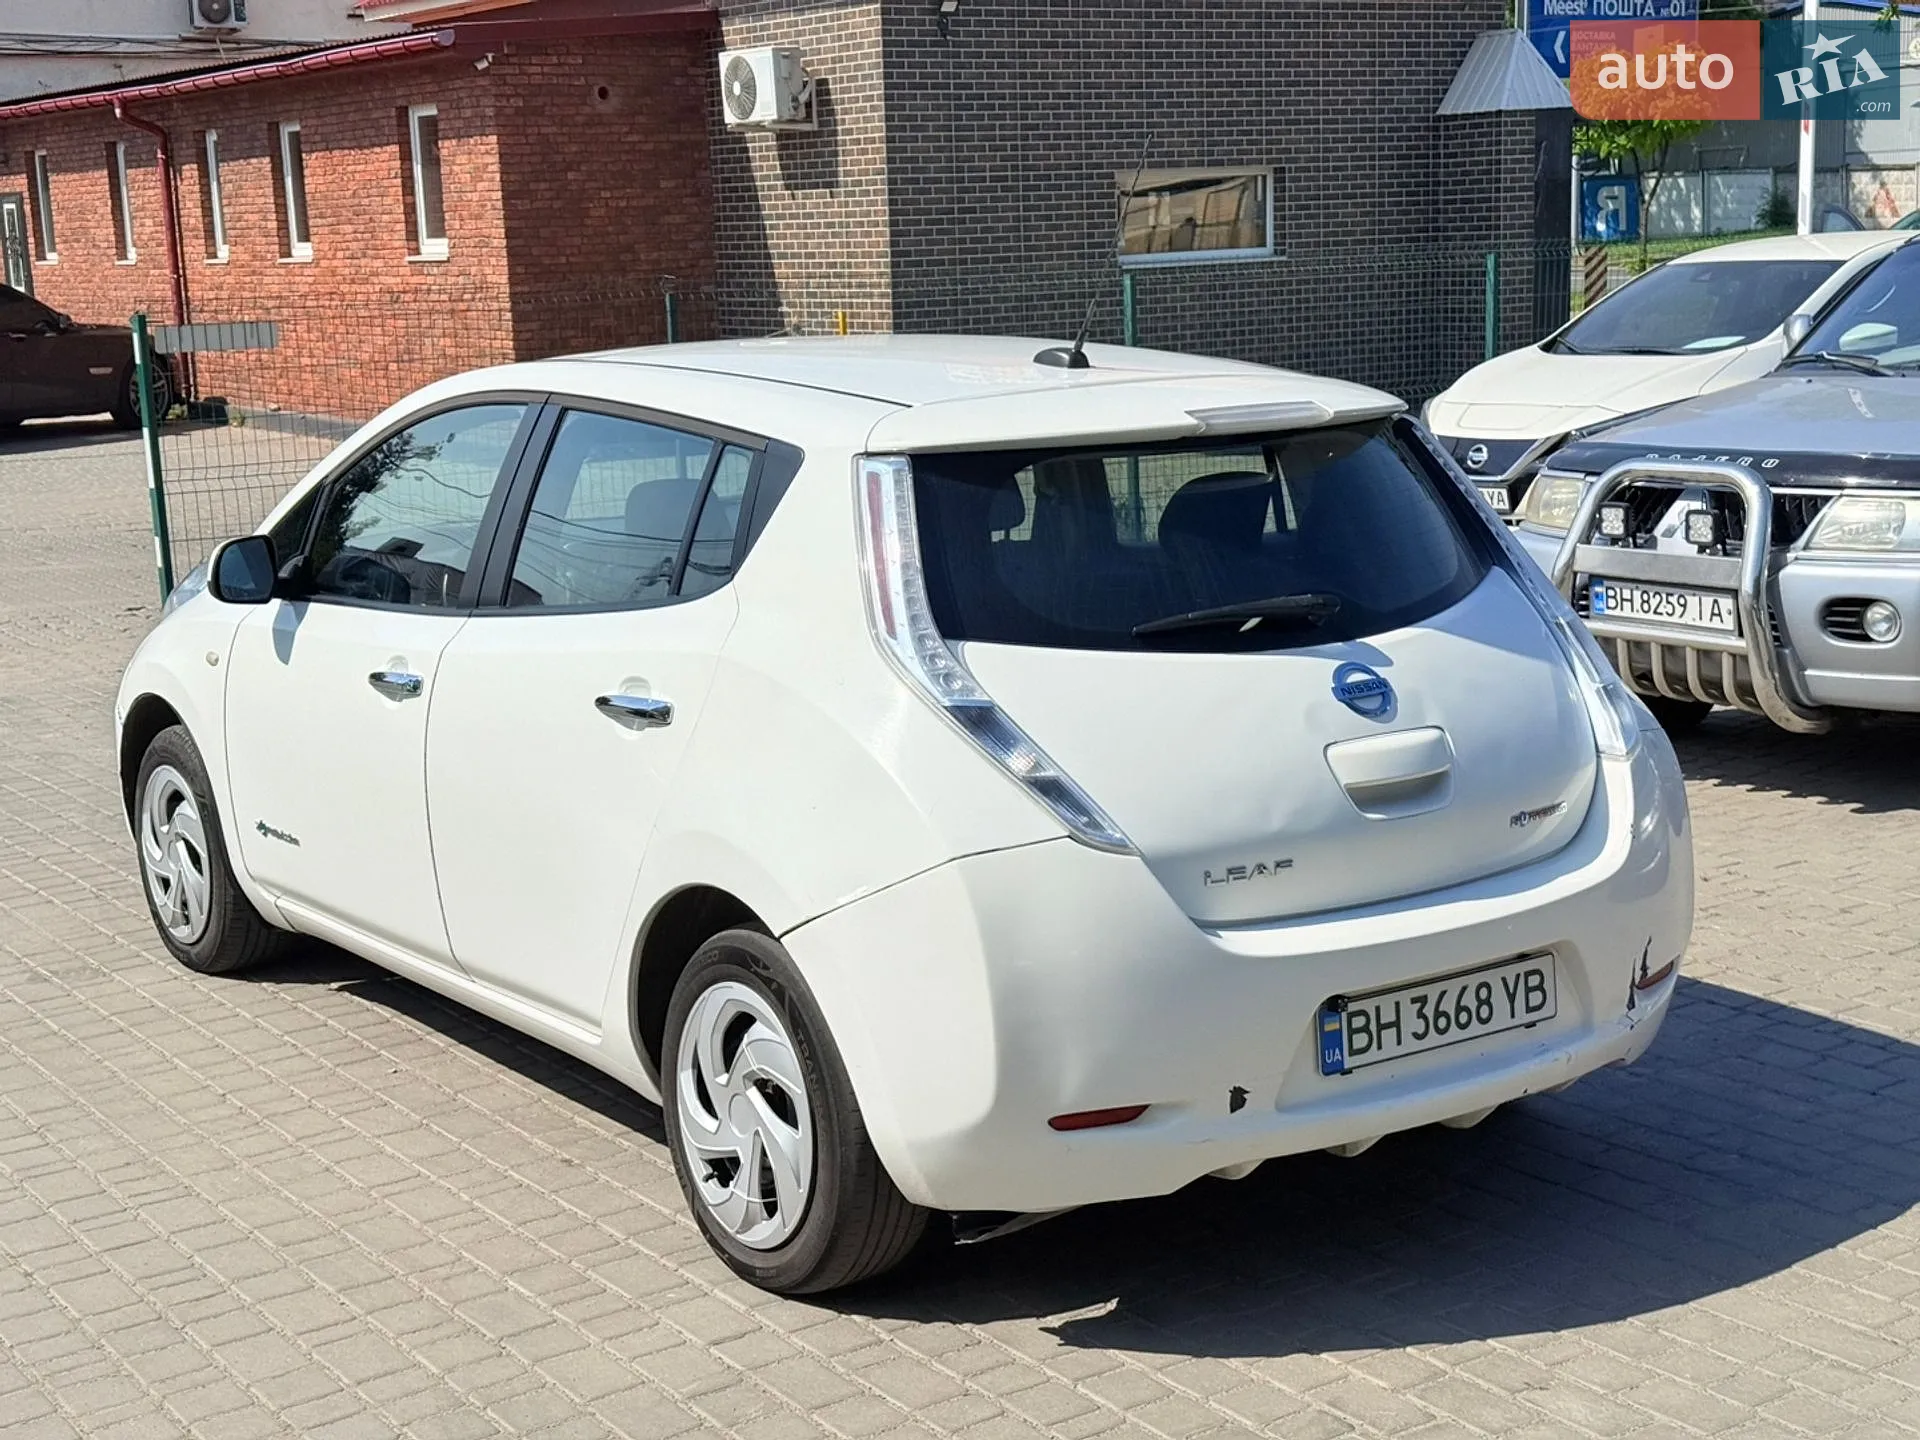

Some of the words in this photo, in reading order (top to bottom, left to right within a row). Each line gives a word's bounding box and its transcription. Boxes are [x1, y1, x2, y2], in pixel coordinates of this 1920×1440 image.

[1593, 0, 1655, 17] ПОШТА
[1605, 586, 1634, 613] BH
[1640, 590, 1687, 619] 8259
[1698, 596, 1724, 624] IA
[1340, 680, 1388, 697] NISSAN
[1204, 858, 1294, 886] LEAF
[1346, 1001, 1402, 1057] BH
[1410, 981, 1494, 1041] 3668
[1501, 968, 1548, 1019] YB
[1325, 1048, 1342, 1063] UA
